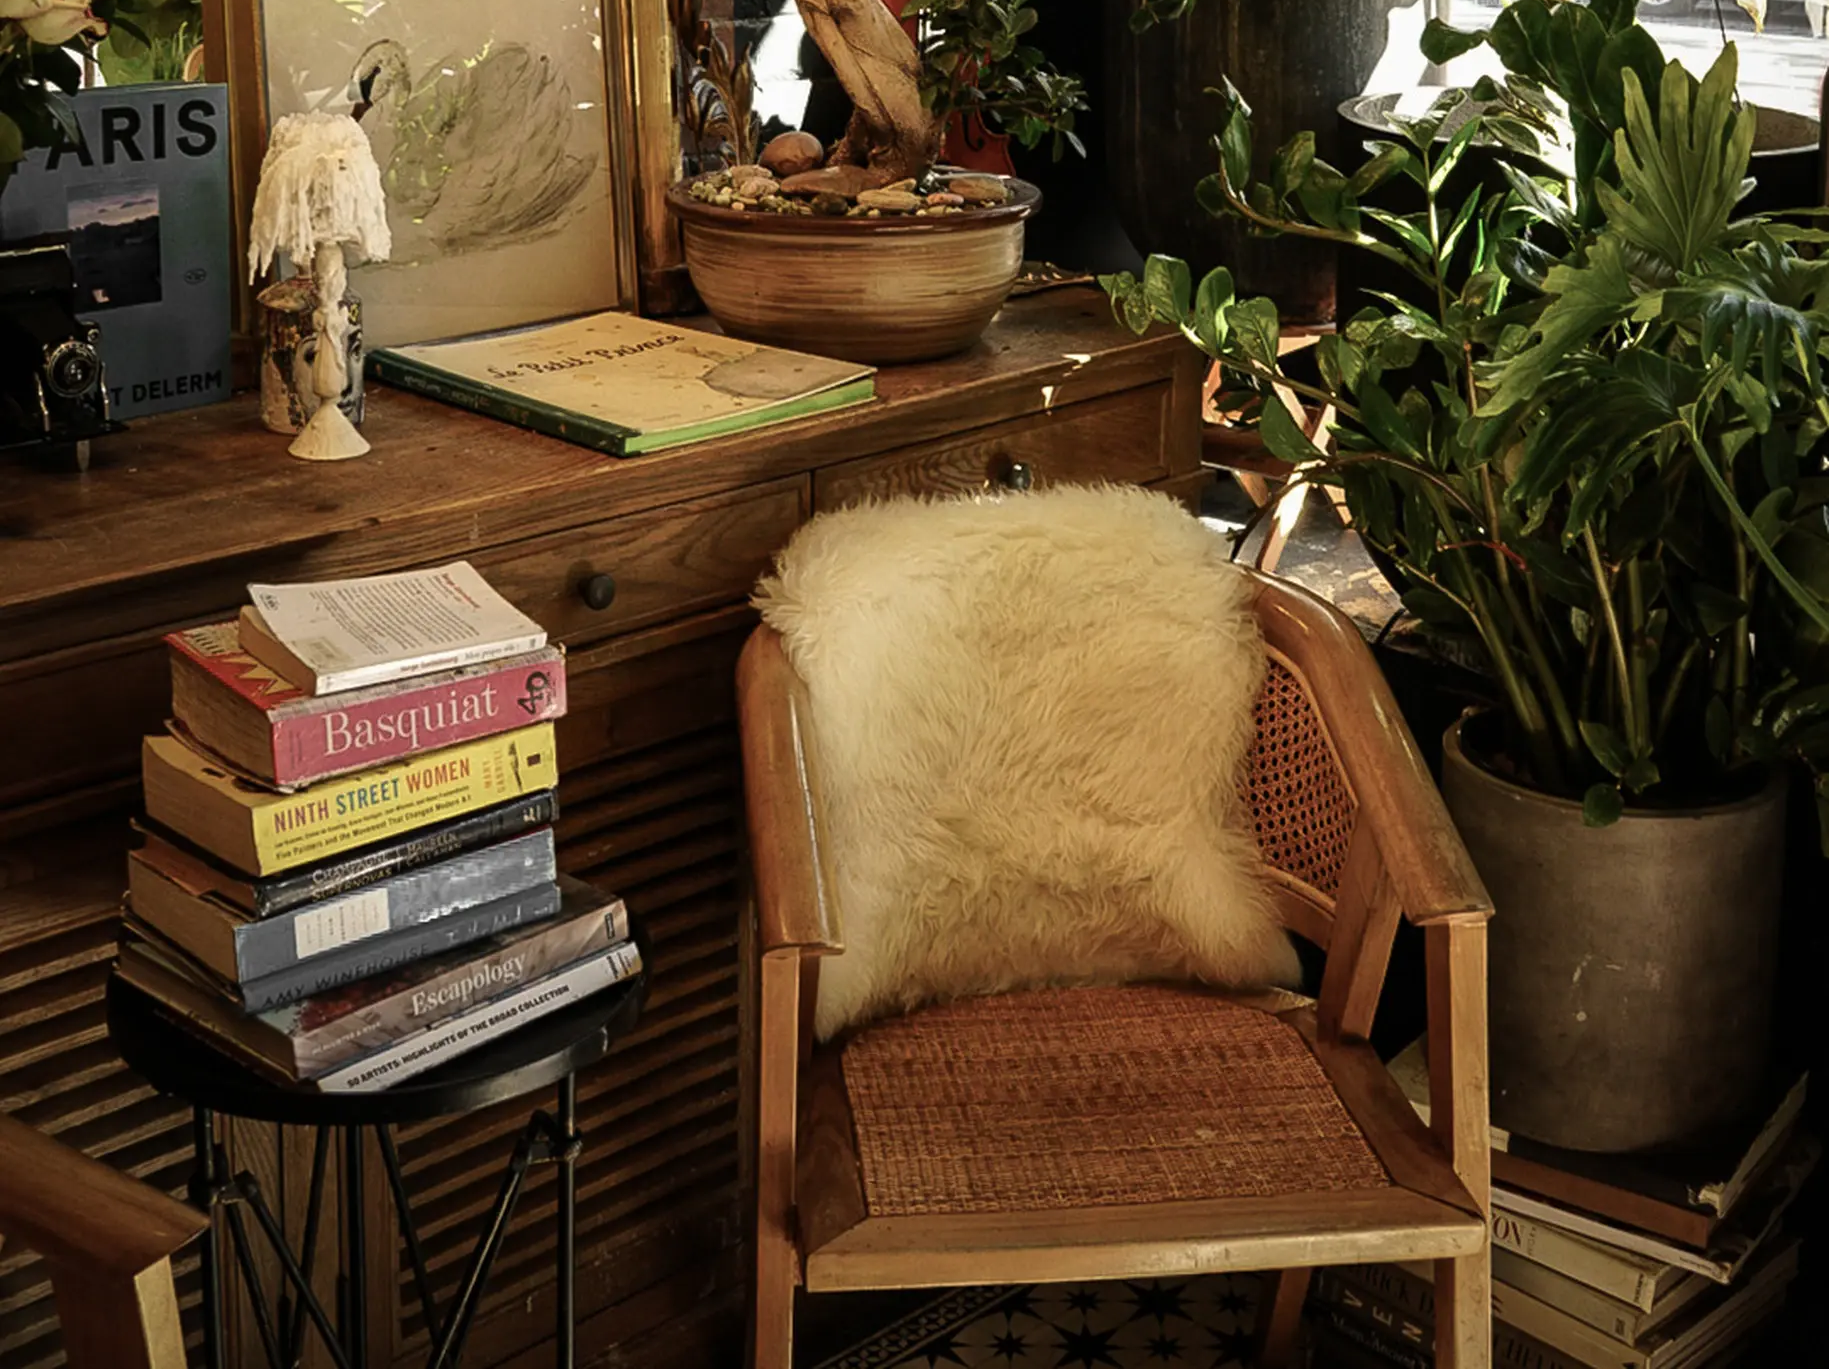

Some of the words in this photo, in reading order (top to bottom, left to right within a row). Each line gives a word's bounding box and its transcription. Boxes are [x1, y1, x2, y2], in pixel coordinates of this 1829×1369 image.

[45, 99, 218, 170] ARIS
[132, 370, 222, 403] DELERM
[321, 682, 500, 756] Basquiat
[273, 798, 330, 834] NINTH
[335, 777, 400, 815] STREET
[405, 757, 470, 794] WOMEN
[351, 819, 387, 836] Movement
[388, 813, 404, 826] That
[404, 805, 434, 821] Changed
[314, 943, 430, 990] WINEHOUSE
[411, 953, 527, 1016] Escapology
[401, 1034, 456, 1065] HIGHLIGHTS
[457, 1027, 469, 1040] OF
[470, 1020, 488, 1035] THE
[488, 1007, 518, 1027] BROAD
[518, 984, 570, 1014] COLLECTION
